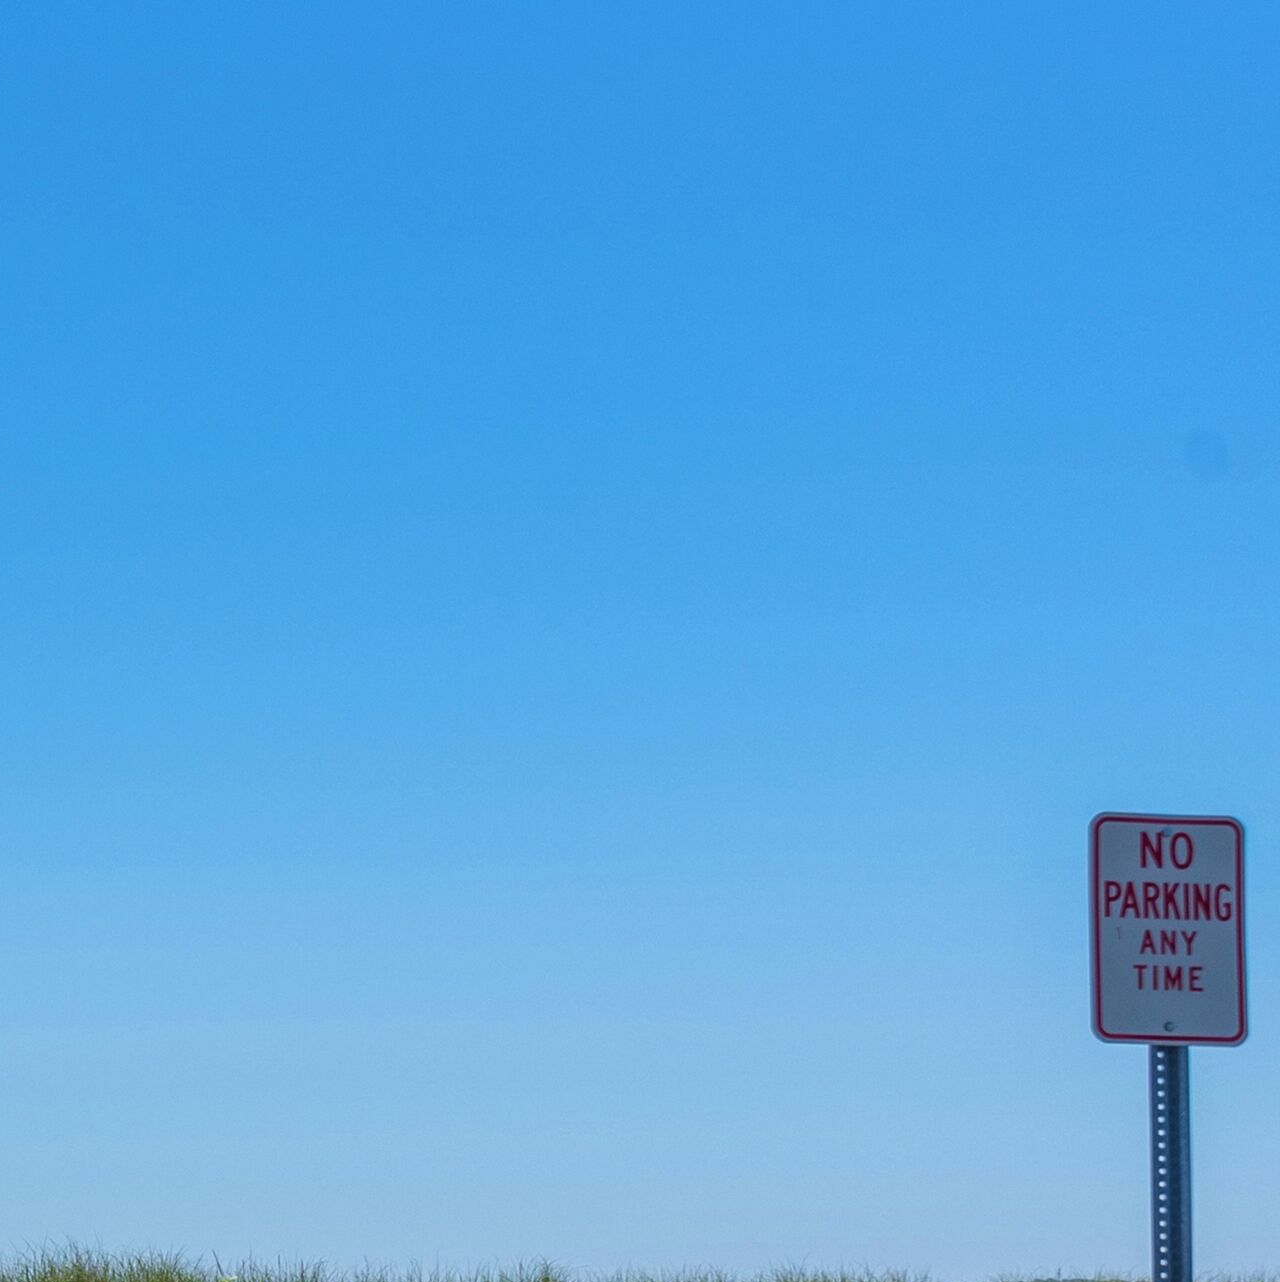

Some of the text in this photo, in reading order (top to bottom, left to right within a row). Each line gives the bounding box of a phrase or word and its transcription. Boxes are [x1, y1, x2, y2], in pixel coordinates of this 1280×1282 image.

[1140, 831, 1194, 869] NO
[1103, 880, 1232, 922] PARKING
[1140, 929, 1198, 956] ANY
[1133, 964, 1204, 992] TIME
